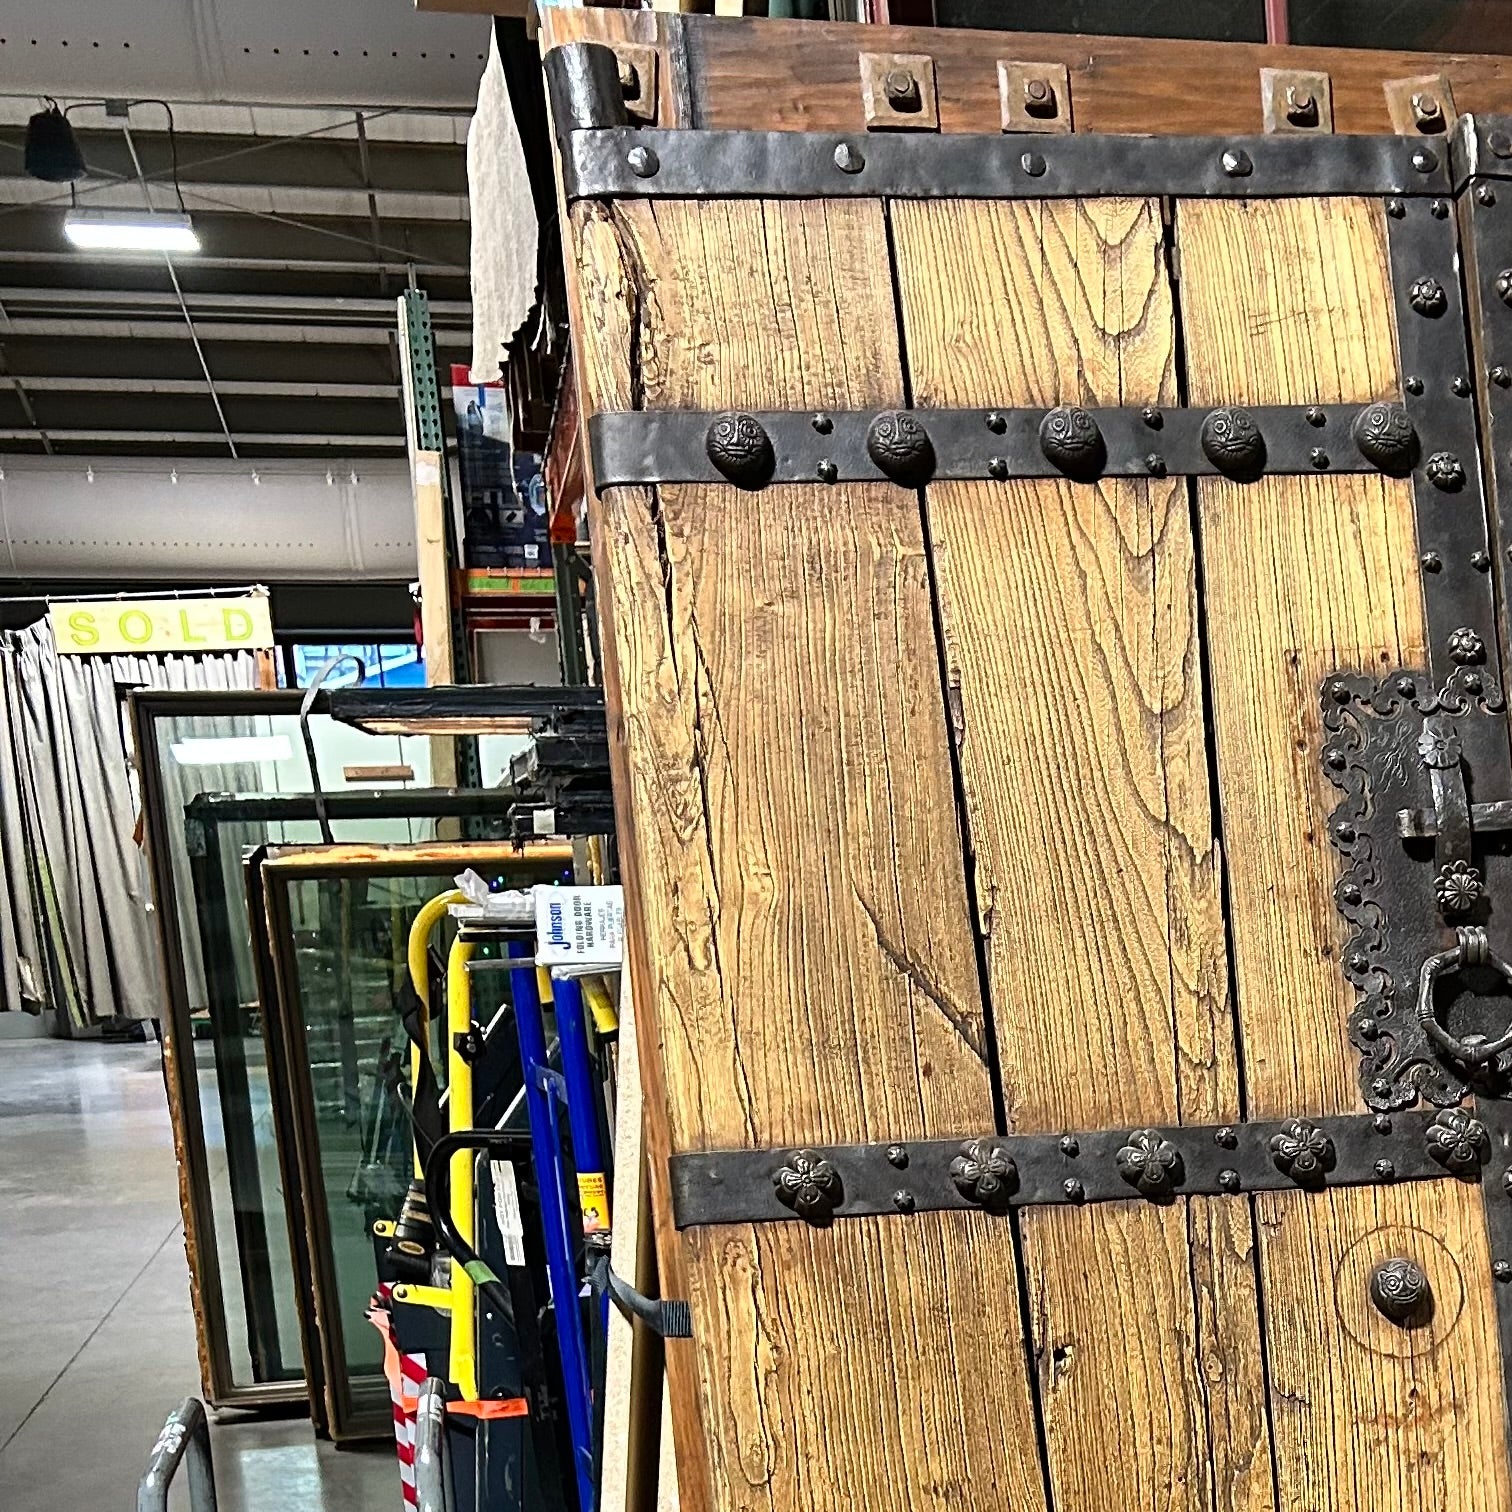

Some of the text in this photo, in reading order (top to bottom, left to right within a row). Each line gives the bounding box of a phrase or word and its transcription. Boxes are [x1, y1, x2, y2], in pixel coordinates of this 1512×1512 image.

[68, 607, 254, 646] SOLD
[546, 902, 571, 950] Johnson
[573, 895, 585, 954] FOLDING DOOR
[584, 902, 594, 948] HARDWARE
